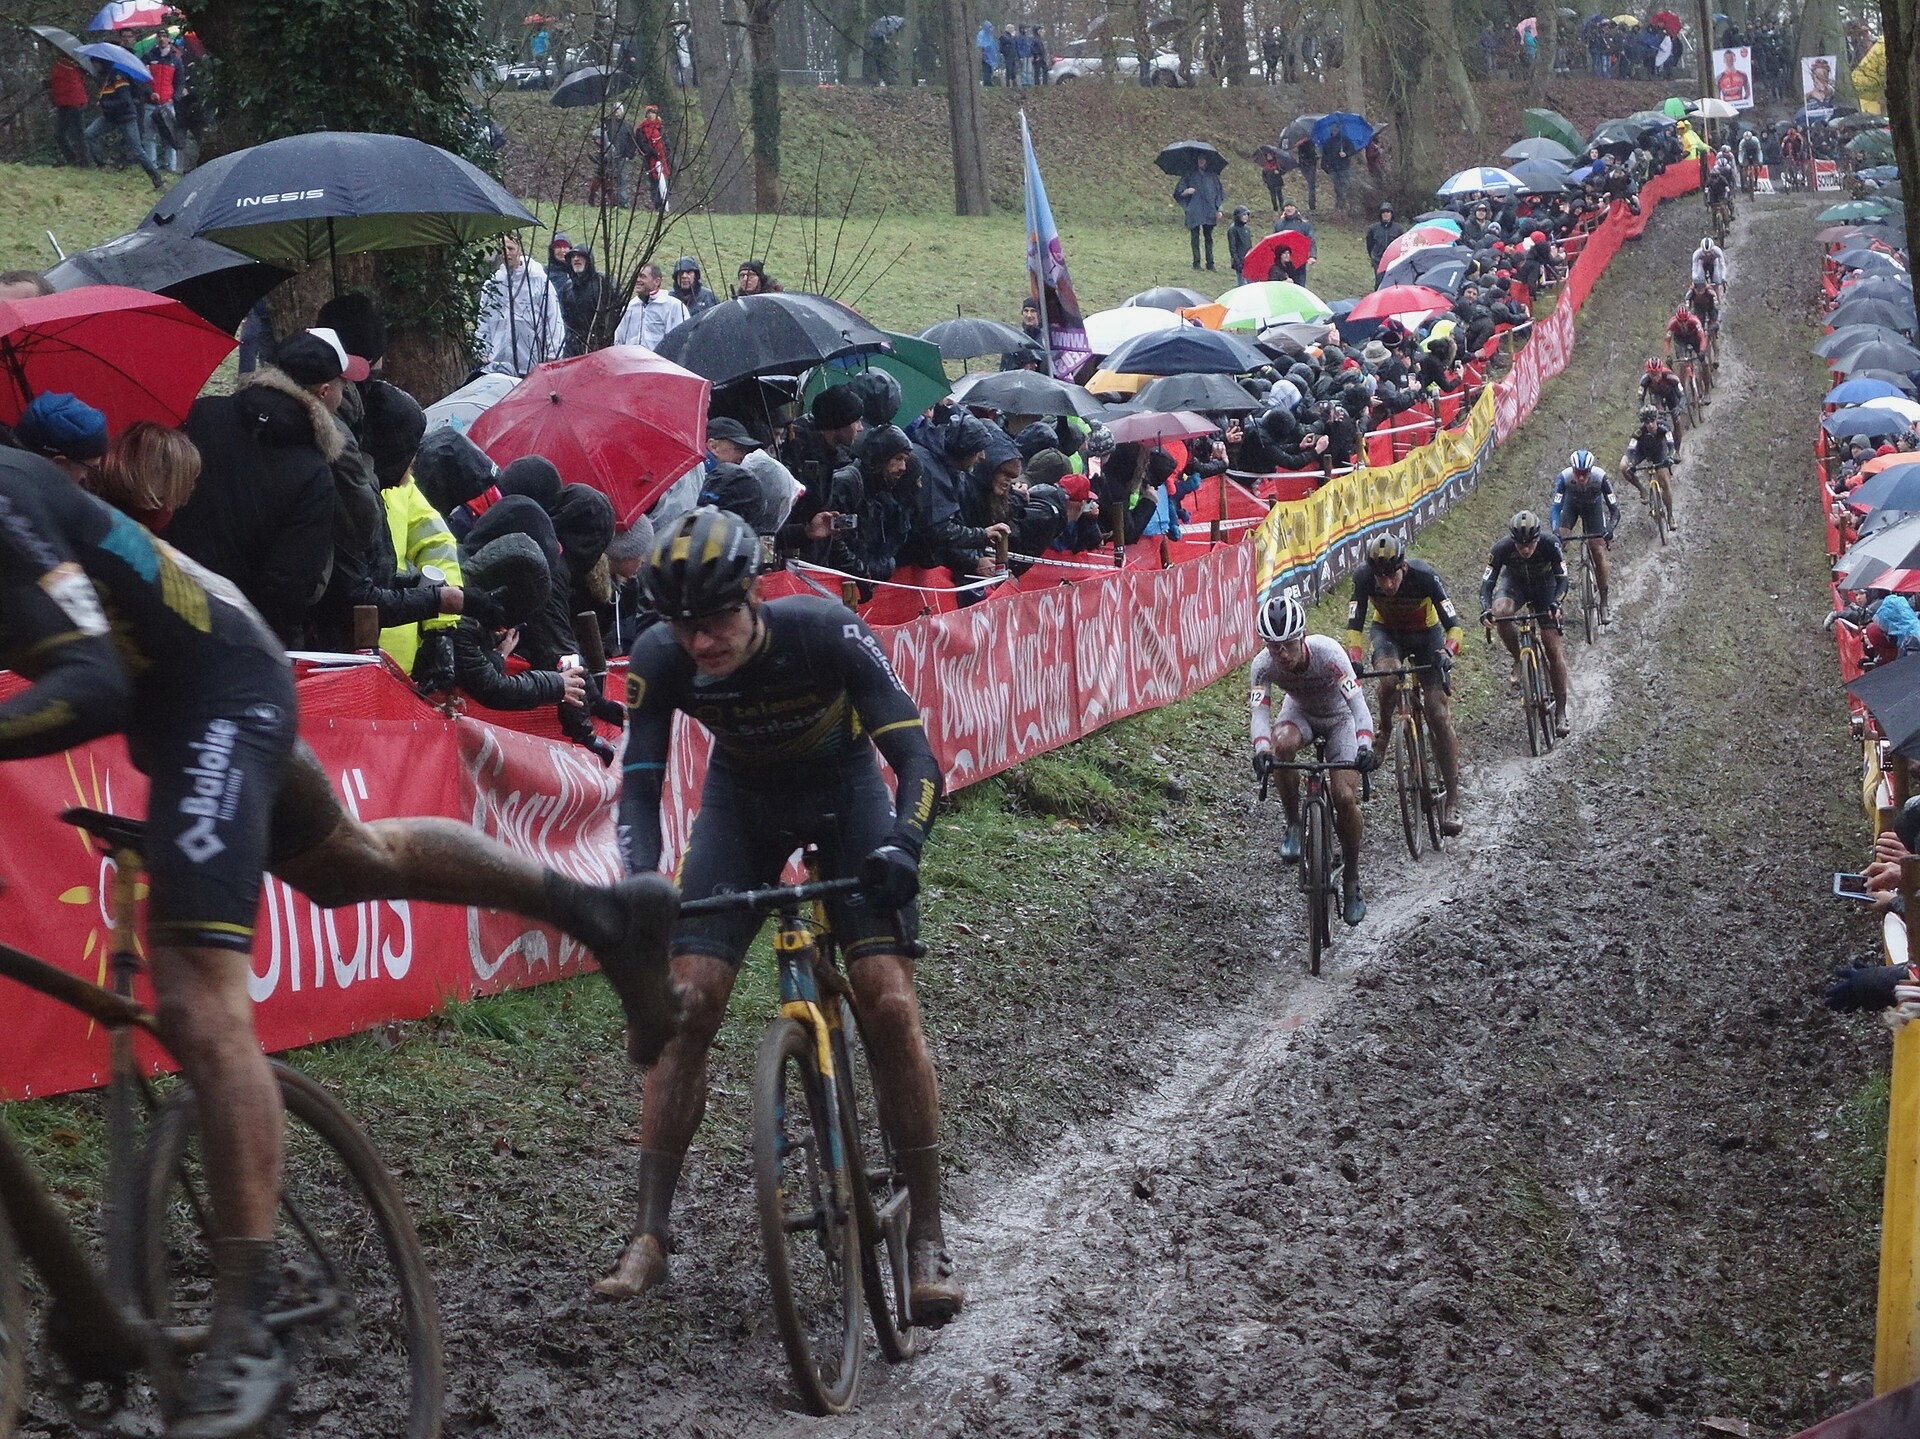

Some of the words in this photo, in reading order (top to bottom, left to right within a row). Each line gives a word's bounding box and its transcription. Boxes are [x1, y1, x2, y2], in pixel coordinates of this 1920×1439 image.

[236, 189, 324, 208] INESIS
[1341, 680, 1356, 693] 12
[1251, 693, 1262, 702] 12
